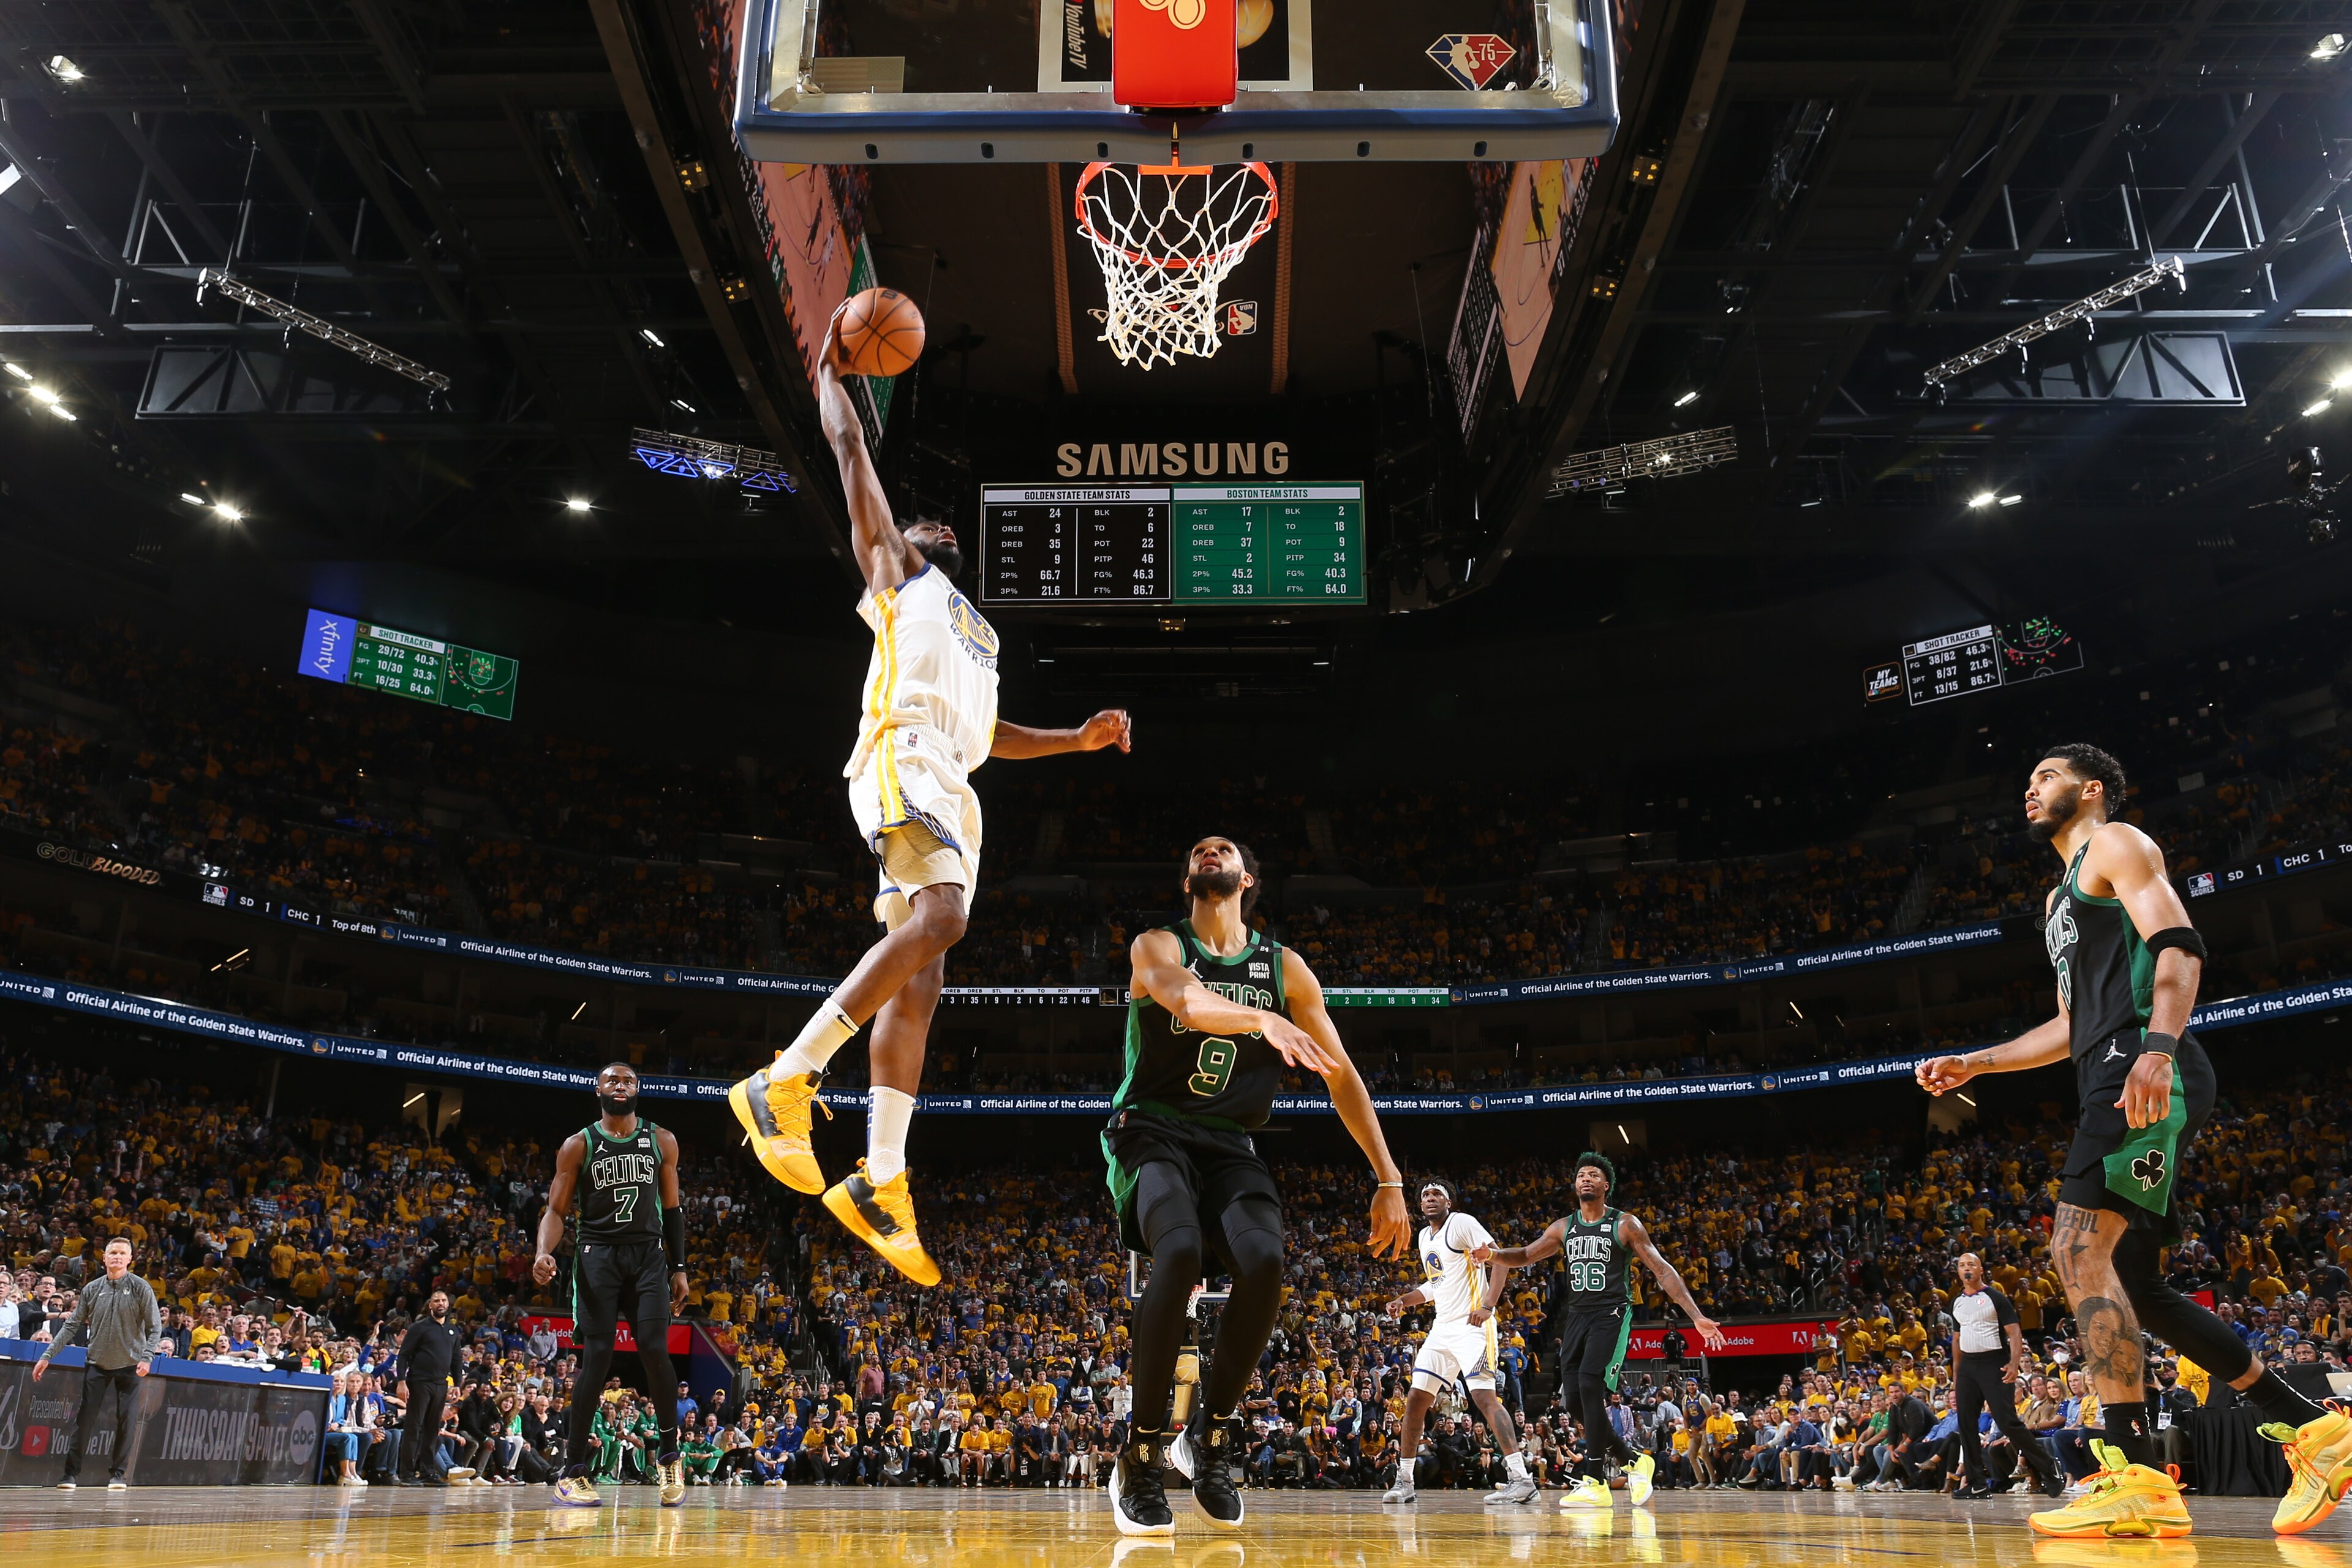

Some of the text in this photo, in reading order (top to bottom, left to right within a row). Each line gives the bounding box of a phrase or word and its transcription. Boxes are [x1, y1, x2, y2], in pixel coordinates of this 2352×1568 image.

[1479, 43, 1496, 61] 75
[1057, 442, 1289, 477] SAMSUNG
[1050, 508, 1060, 518] 24
[1148, 508, 1153, 516] 2
[1242, 507, 1251, 516] 17
[1339, 506, 1344, 515] 2
[1055, 524, 1060, 533] 3
[1148, 523, 1153, 532] 6
[1246, 522, 1251, 531] 7
[1335, 522, 1344, 530] 18
[1050, 539, 1060, 548] 35
[1142, 538, 1153, 548] 22
[1241, 538, 1251, 547] 37
[1340, 537, 1344, 546] 9
[1055, 555, 1060, 564] 9
[1142, 554, 1153, 563] 46
[1246, 553, 1252, 562] 2
[1334, 552, 1345, 562] 34
[1041, 570, 1060, 579] 66.7
[1133, 570, 1153, 579] 46.3
[1232, 569, 1252, 578] 45.2
[1325, 568, 1346, 578] 40.3
[1042, 586, 1060, 595] 21.6
[1134, 585, 1153, 594] 86.7
[1233, 584, 1252, 594] 33.3
[1326, 584, 1346, 593] 64.0
[978, 617, 993, 638] 22
[379, 630, 434, 649] SHOT TRACKER
[1924, 630, 1980, 650] SHOT TRACKER
[378, 645, 405, 658] 29/72
[1929, 652, 1956, 665] 38/82
[377, 660, 402, 673] 10/30
[1877, 669, 1890, 680] MY
[1937, 666, 1957, 679] 8/37
[375, 675, 400, 688] 16/25
[1869, 676, 1898, 690] TEAMS
[1935, 681, 1958, 694] 13/15
[203, 894, 225, 906] SCORES
[240, 897, 376, 934] SD 1 CHC 1 Top of 8th
[403, 933, 435, 943] UNITED
[461, 941, 493, 953] Official
[496, 948, 526, 959] Airline
[540, 954, 553, 963] the
[556, 957, 585, 968] Golden
[588, 962, 609, 972] State
[612, 966, 651, 978] Warriors.
[1248, 962, 1270, 972] VISTA
[67, 992, 304, 1047] Official Airline of the Golden State Warriors.
[337, 1046, 375, 1056] UNITED
[1188, 1036, 1237, 1096] 9
[1543, 1092, 1576, 1102] Official
[1579, 1090, 1611, 1099] Airline
[1614, 1089, 1623, 1098] of
[1644, 1082, 1678, 1096] Golden
[1681, 1085, 1706, 1093] State
[1708, 1082, 1754, 1091] Warriors.
[592, 1154, 654, 1189] CELTICS
[614, 1186, 638, 1223] 7
[1566, 1235, 1611, 1263] CELTICS
[1434, 1258, 1439, 1267] 5
[1570, 1262, 1605, 1291] 36
[552, 1328, 573, 1337] Adob
[29, 1395, 74, 1423] Presented by
[159, 1408, 244, 1461] THURSDAY
[271, 1427, 287, 1461] ET
[292, 1427, 317, 1446] abc
